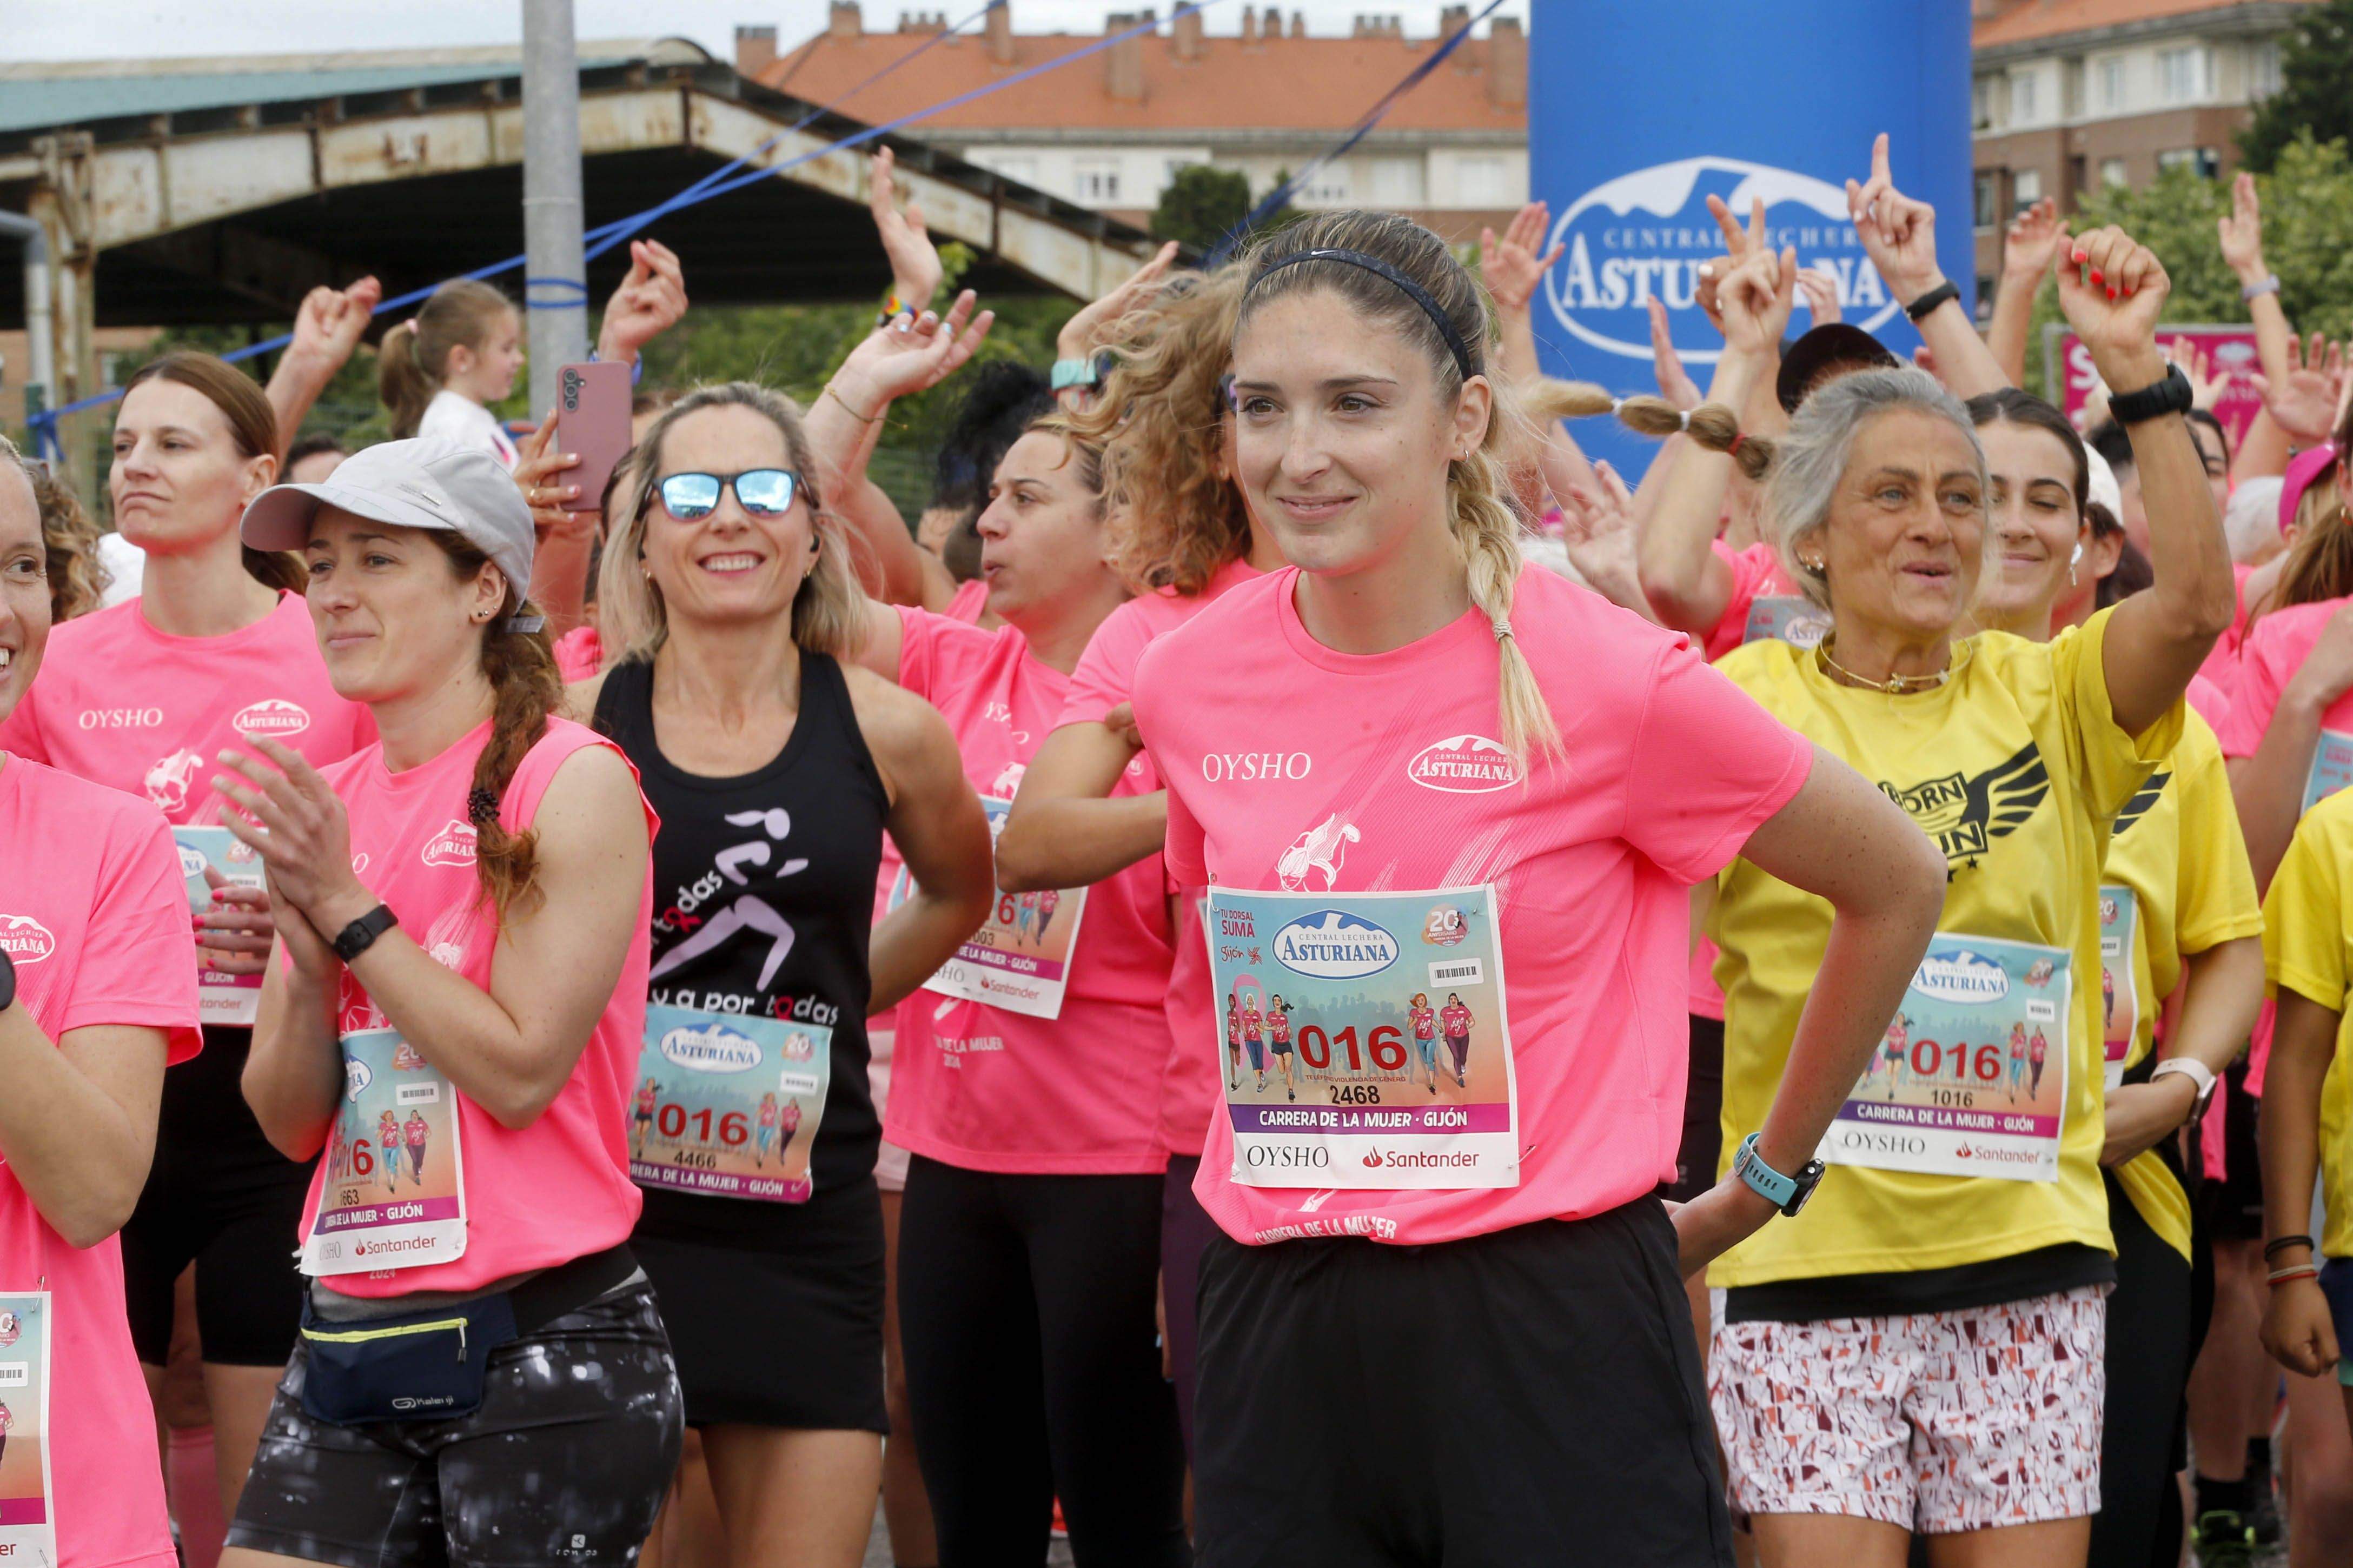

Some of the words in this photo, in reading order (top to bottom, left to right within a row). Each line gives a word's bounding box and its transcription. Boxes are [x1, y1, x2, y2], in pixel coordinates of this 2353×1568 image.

[79, 708, 163, 730] OYSHO
[240, 714, 303, 728] ASTURIANA
[1202, 752, 1311, 782] OYSHO
[1414, 756, 1514, 781] ASTURIANA
[1474, 755, 1508, 763] LECHER
[1221, 908, 1228, 919] TU
[1229, 909, 1255, 921] DORSAL
[1429, 909, 1459, 932] 20
[1222, 919, 1255, 938] SUMA
[969, 948, 979, 959] LA
[979, 951, 1006, 965] MUJER
[1221, 945, 1244, 963] gijón
[1282, 935, 1391, 961] ASTURIANA
[990, 980, 1040, 999] Santander
[1914, 965, 2006, 994] ASTURIANA
[703, 991, 755, 1015] por
[765, 994, 838, 1026] todas
[666, 1035, 755, 1065] ASTURIANA
[1298, 1025, 1407, 1071] 016
[1911, 1039, 2001, 1081] 016
[1330, 1085, 1381, 1105] 2468
[1931, 1089, 1973, 1107] 1016
[658, 1104, 748, 1145] 016
[1260, 1110, 1317, 1126] CARRERA
[1320, 1111, 1338, 1127] DE
[1343, 1112, 1360, 1127] LA
[1364, 1111, 1411, 1128] MUJER
[1423, 1107, 1468, 1127] GIJÓN
[1857, 1104, 1914, 1121] CARRERA
[1918, 1111, 1934, 1125] DE
[1938, 1112, 1952, 1126] LA
[1956, 1113, 1994, 1130] MUJER
[2004, 1115, 2034, 1132] GIJÓN
[1247, 1145, 1329, 1168] OYSHO
[1386, 1150, 1480, 1168] Santander
[1844, 1131, 1925, 1155] OYSHO
[1975, 1146, 2039, 1164] Santander
[674, 1150, 717, 1169] 4466
[662, 1168, 677, 1183] DE
[680, 1171, 695, 1186] LA
[698, 1173, 739, 1191] MUJER
[749, 1178, 784, 1196] GIJÓN
[351, 1209, 377, 1224] MUJER
[387, 1202, 423, 1220] GIJÓN
[1255, 1224, 1301, 1245] CARRERA
[1303, 1219, 1323, 1238] DE
[1324, 1219, 1343, 1235] LA
[367, 1236, 437, 1255] Santander
